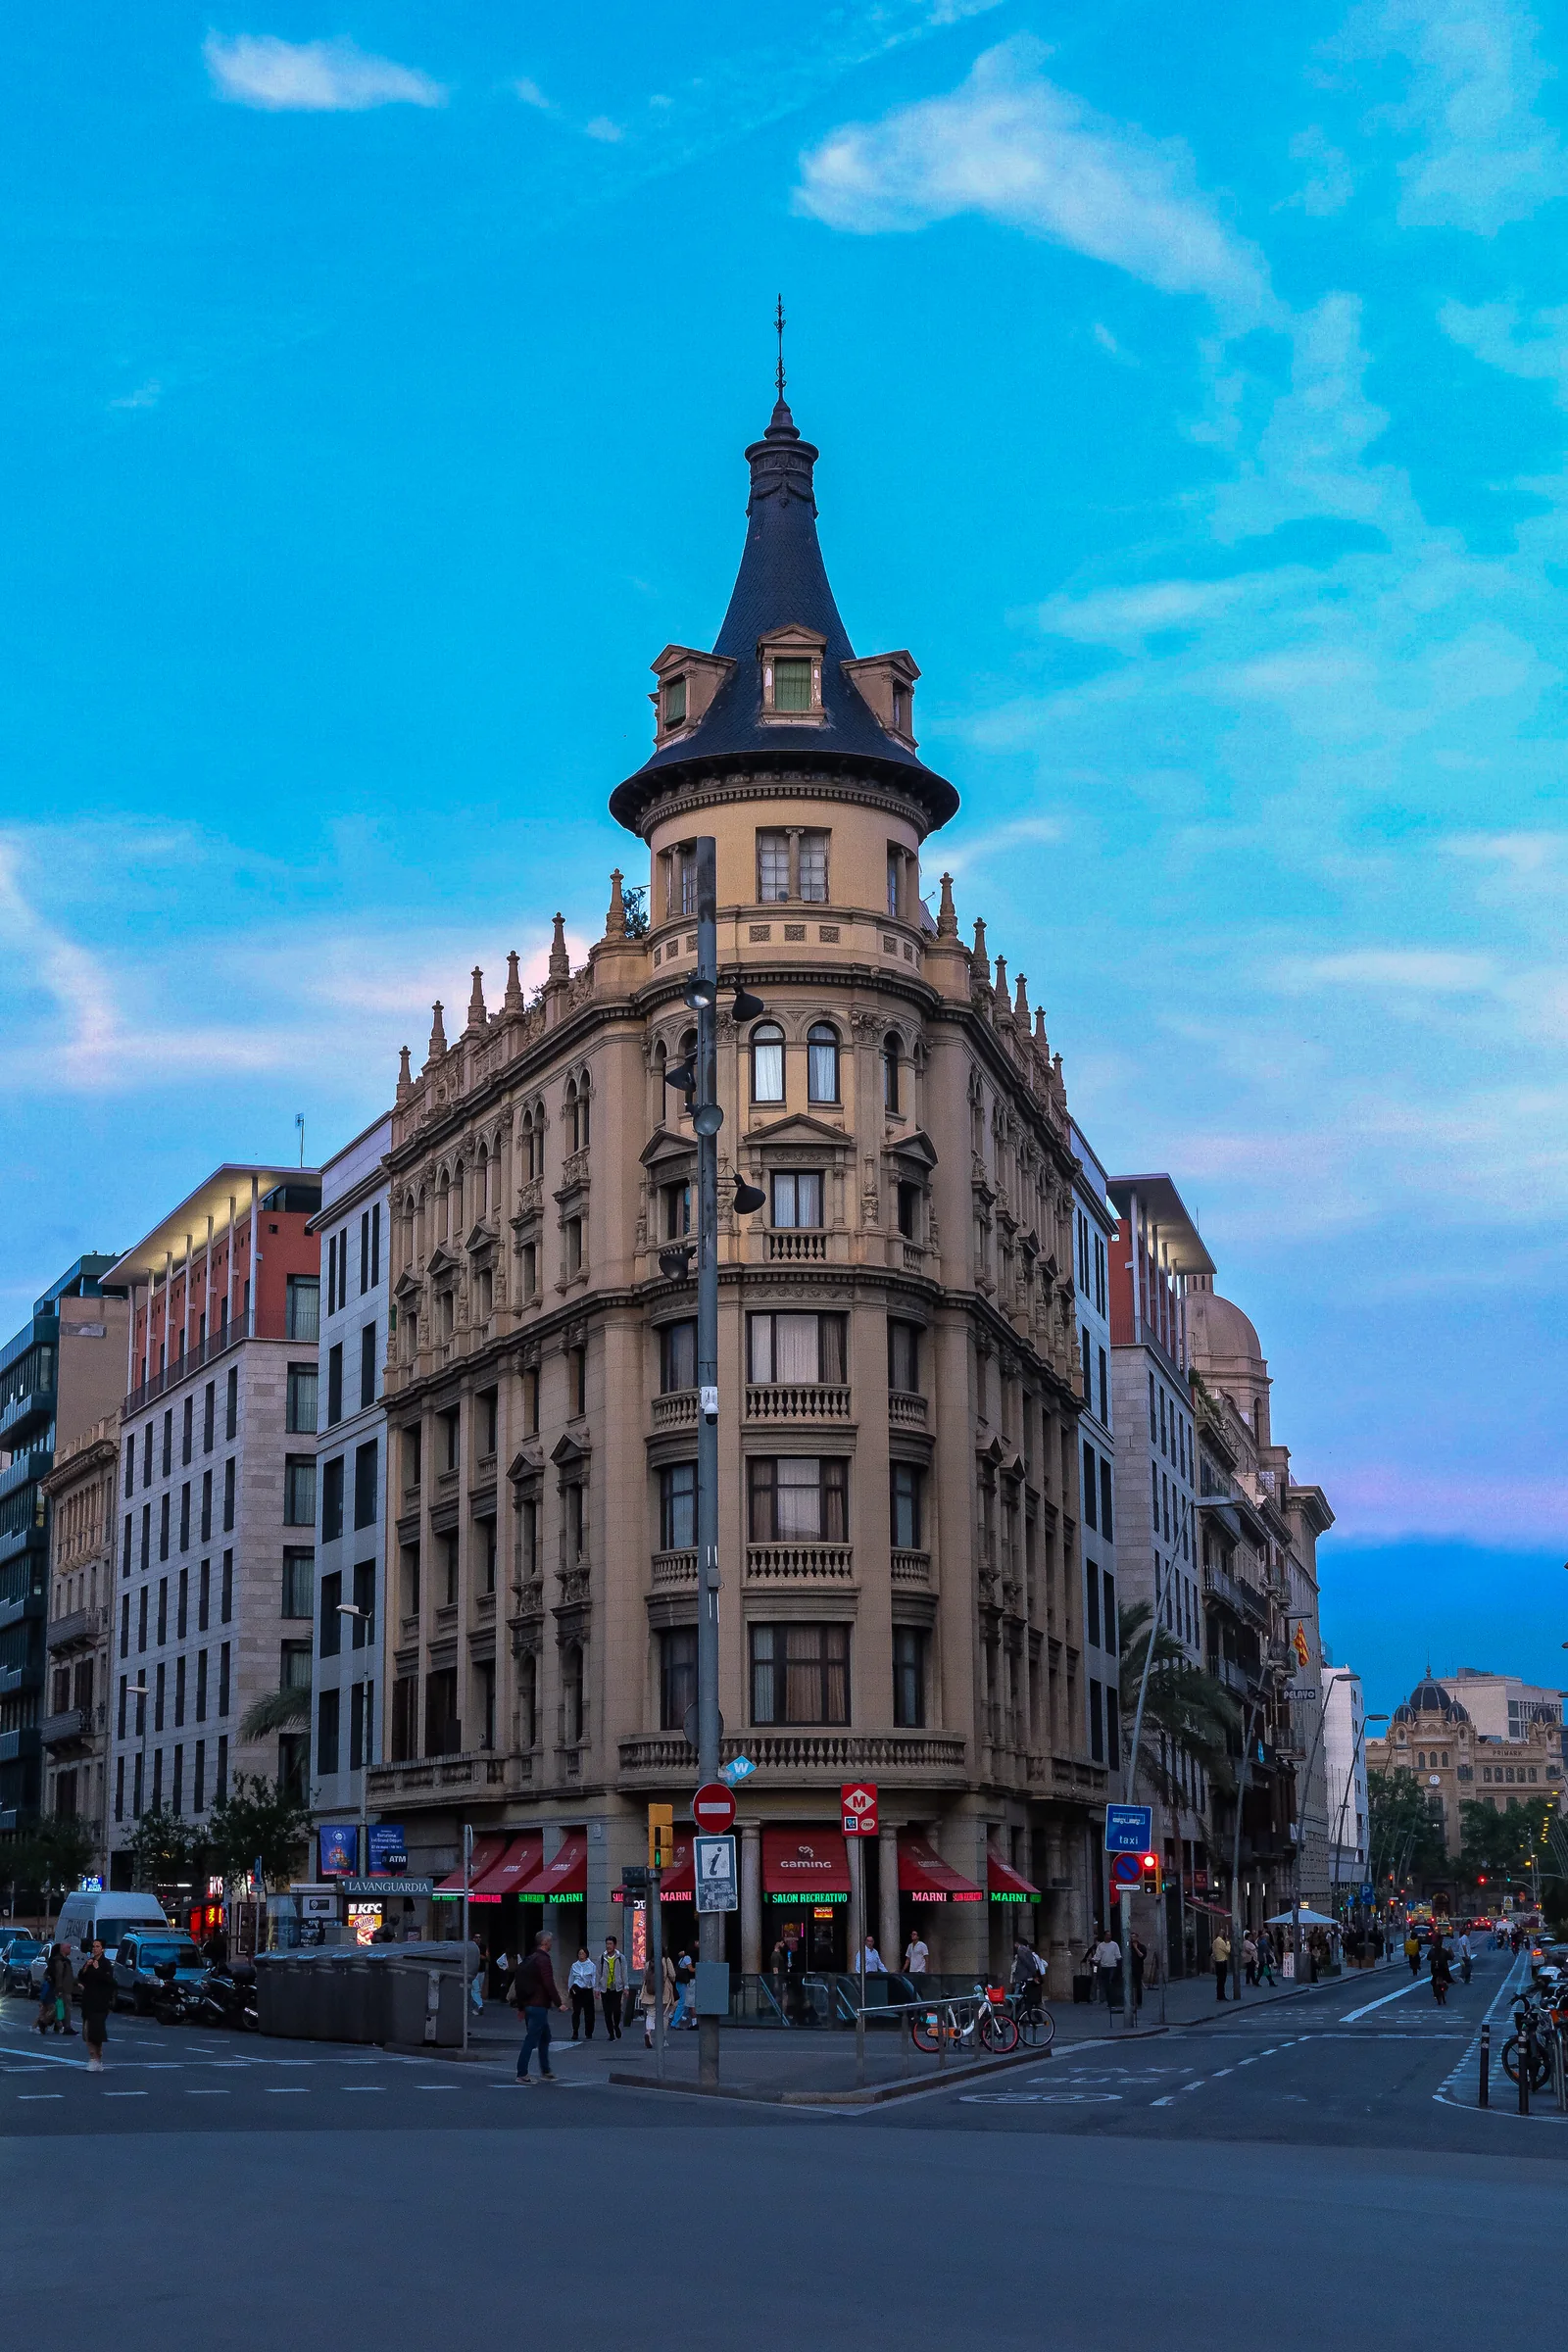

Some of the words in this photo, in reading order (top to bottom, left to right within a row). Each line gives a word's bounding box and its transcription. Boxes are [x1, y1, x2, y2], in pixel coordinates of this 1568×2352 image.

[1284, 1690, 1314, 1699] PELAYO
[733, 1763, 749, 1773] W
[853, 1796, 865, 1807] M
[1119, 1836, 1139, 1844] taxi
[348, 1882, 362, 1891] LA
[362, 1882, 429, 1892] VANGUARDIA
[1362, 1886, 1370, 1896] P
[549, 1893, 583, 1903] MARNI
[660, 1891, 692, 1901] MARNI
[772, 1893, 799, 1903] SALON
[800, 1893, 848, 1903] RECREATIVO
[911, 1891, 947, 1902] MARNI
[991, 1892, 1027, 1902] MARNI
[357, 1903, 383, 1914] KFC
